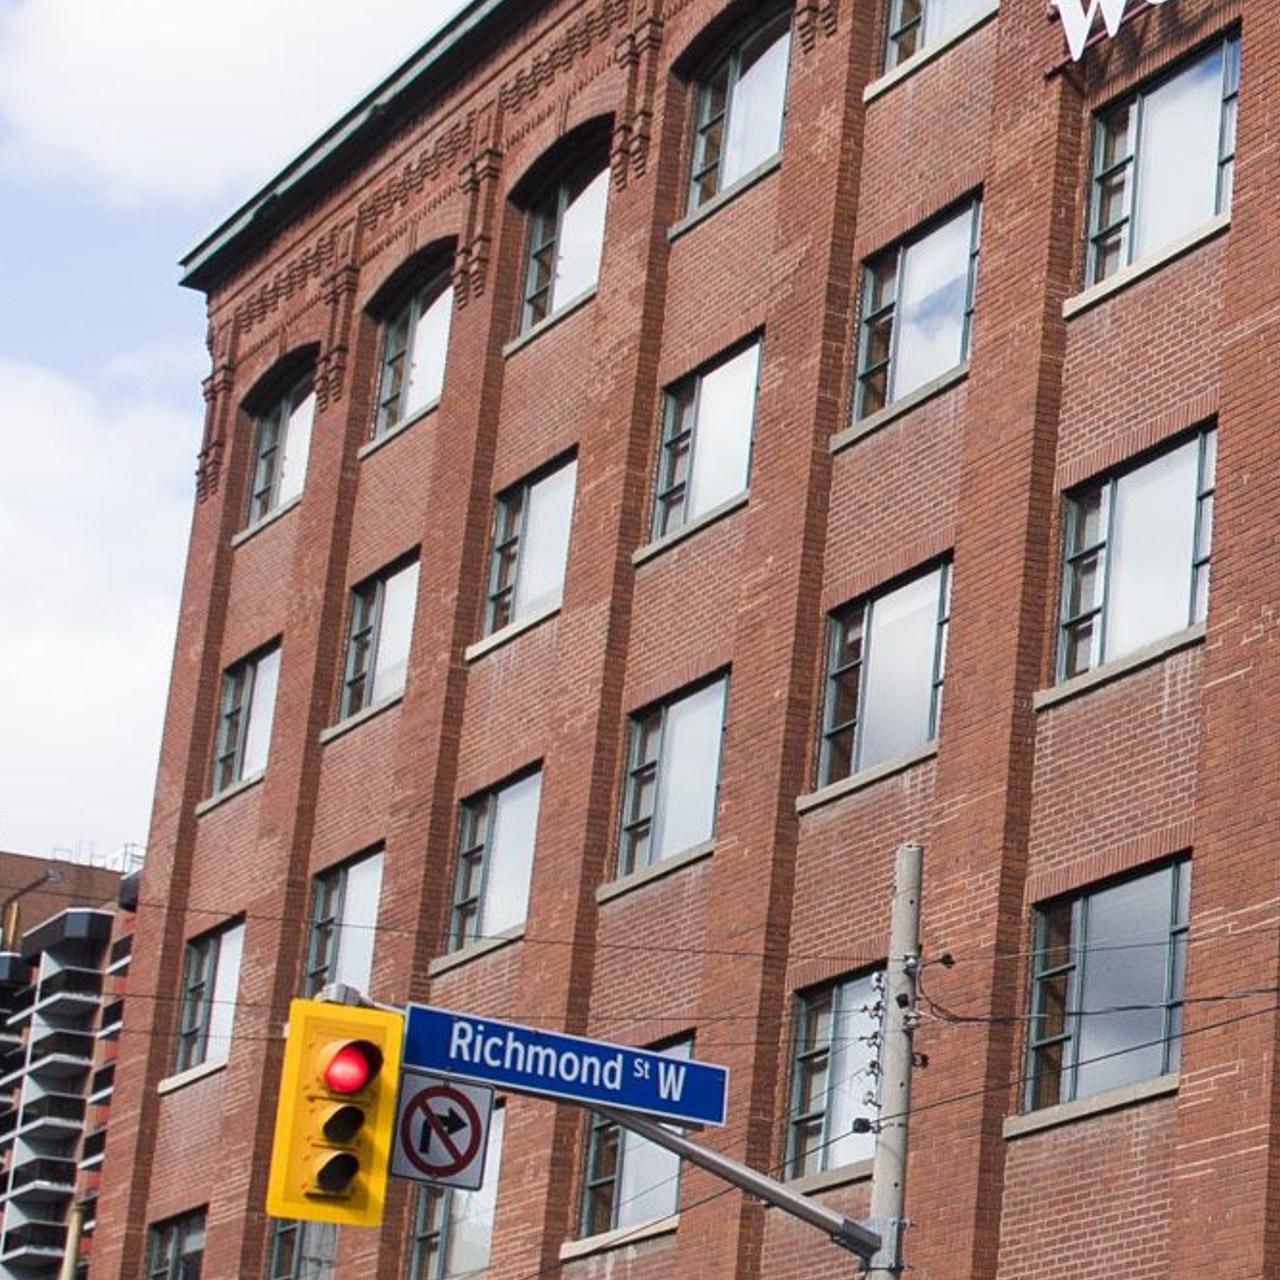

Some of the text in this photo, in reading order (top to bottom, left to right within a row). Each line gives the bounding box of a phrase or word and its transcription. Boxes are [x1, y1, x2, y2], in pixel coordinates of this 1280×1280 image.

[450, 1021, 686, 1102] Richmond St W
